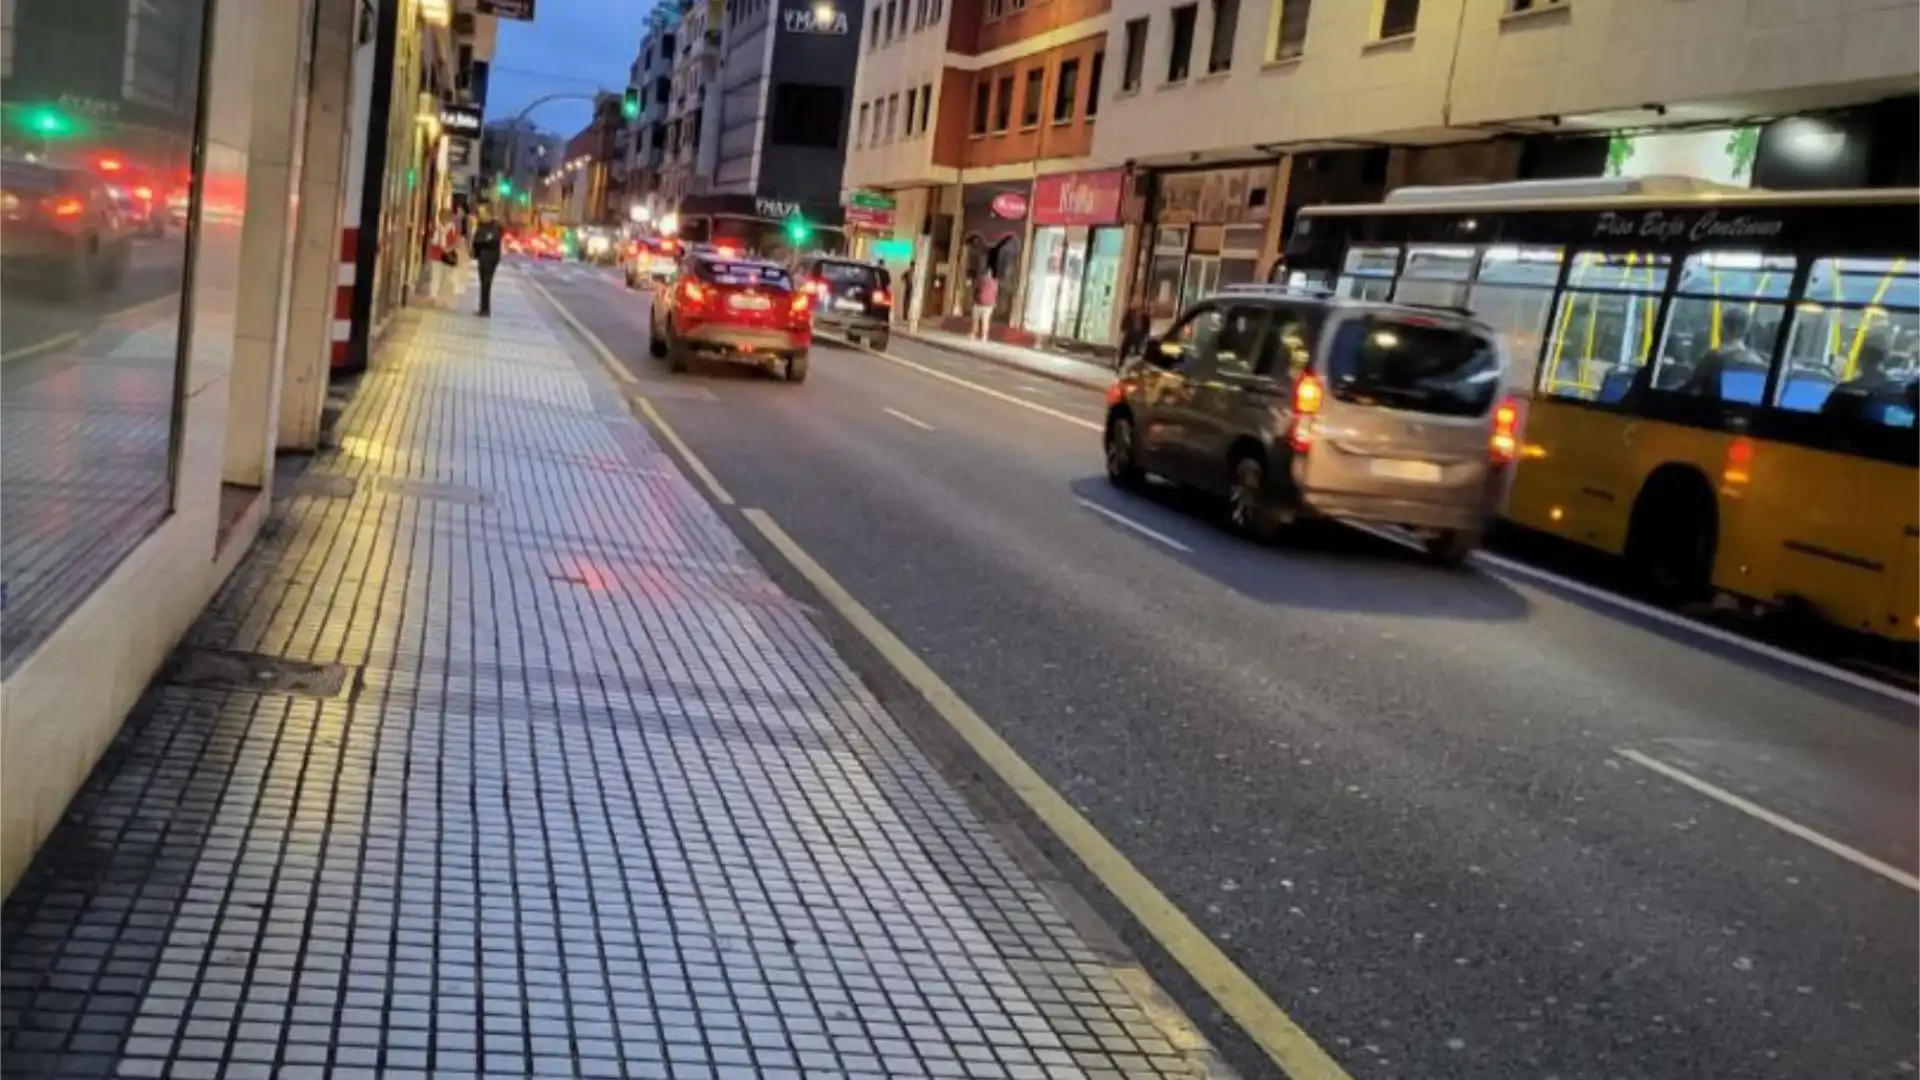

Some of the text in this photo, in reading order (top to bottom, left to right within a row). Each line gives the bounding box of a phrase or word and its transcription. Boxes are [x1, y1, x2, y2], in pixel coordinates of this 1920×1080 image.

[783, 8, 848, 35] YMAA
[756, 198, 800, 217] YMAYA
[1594, 211, 1634, 237] Piso
[1639, 211, 1684, 242] Bajo
